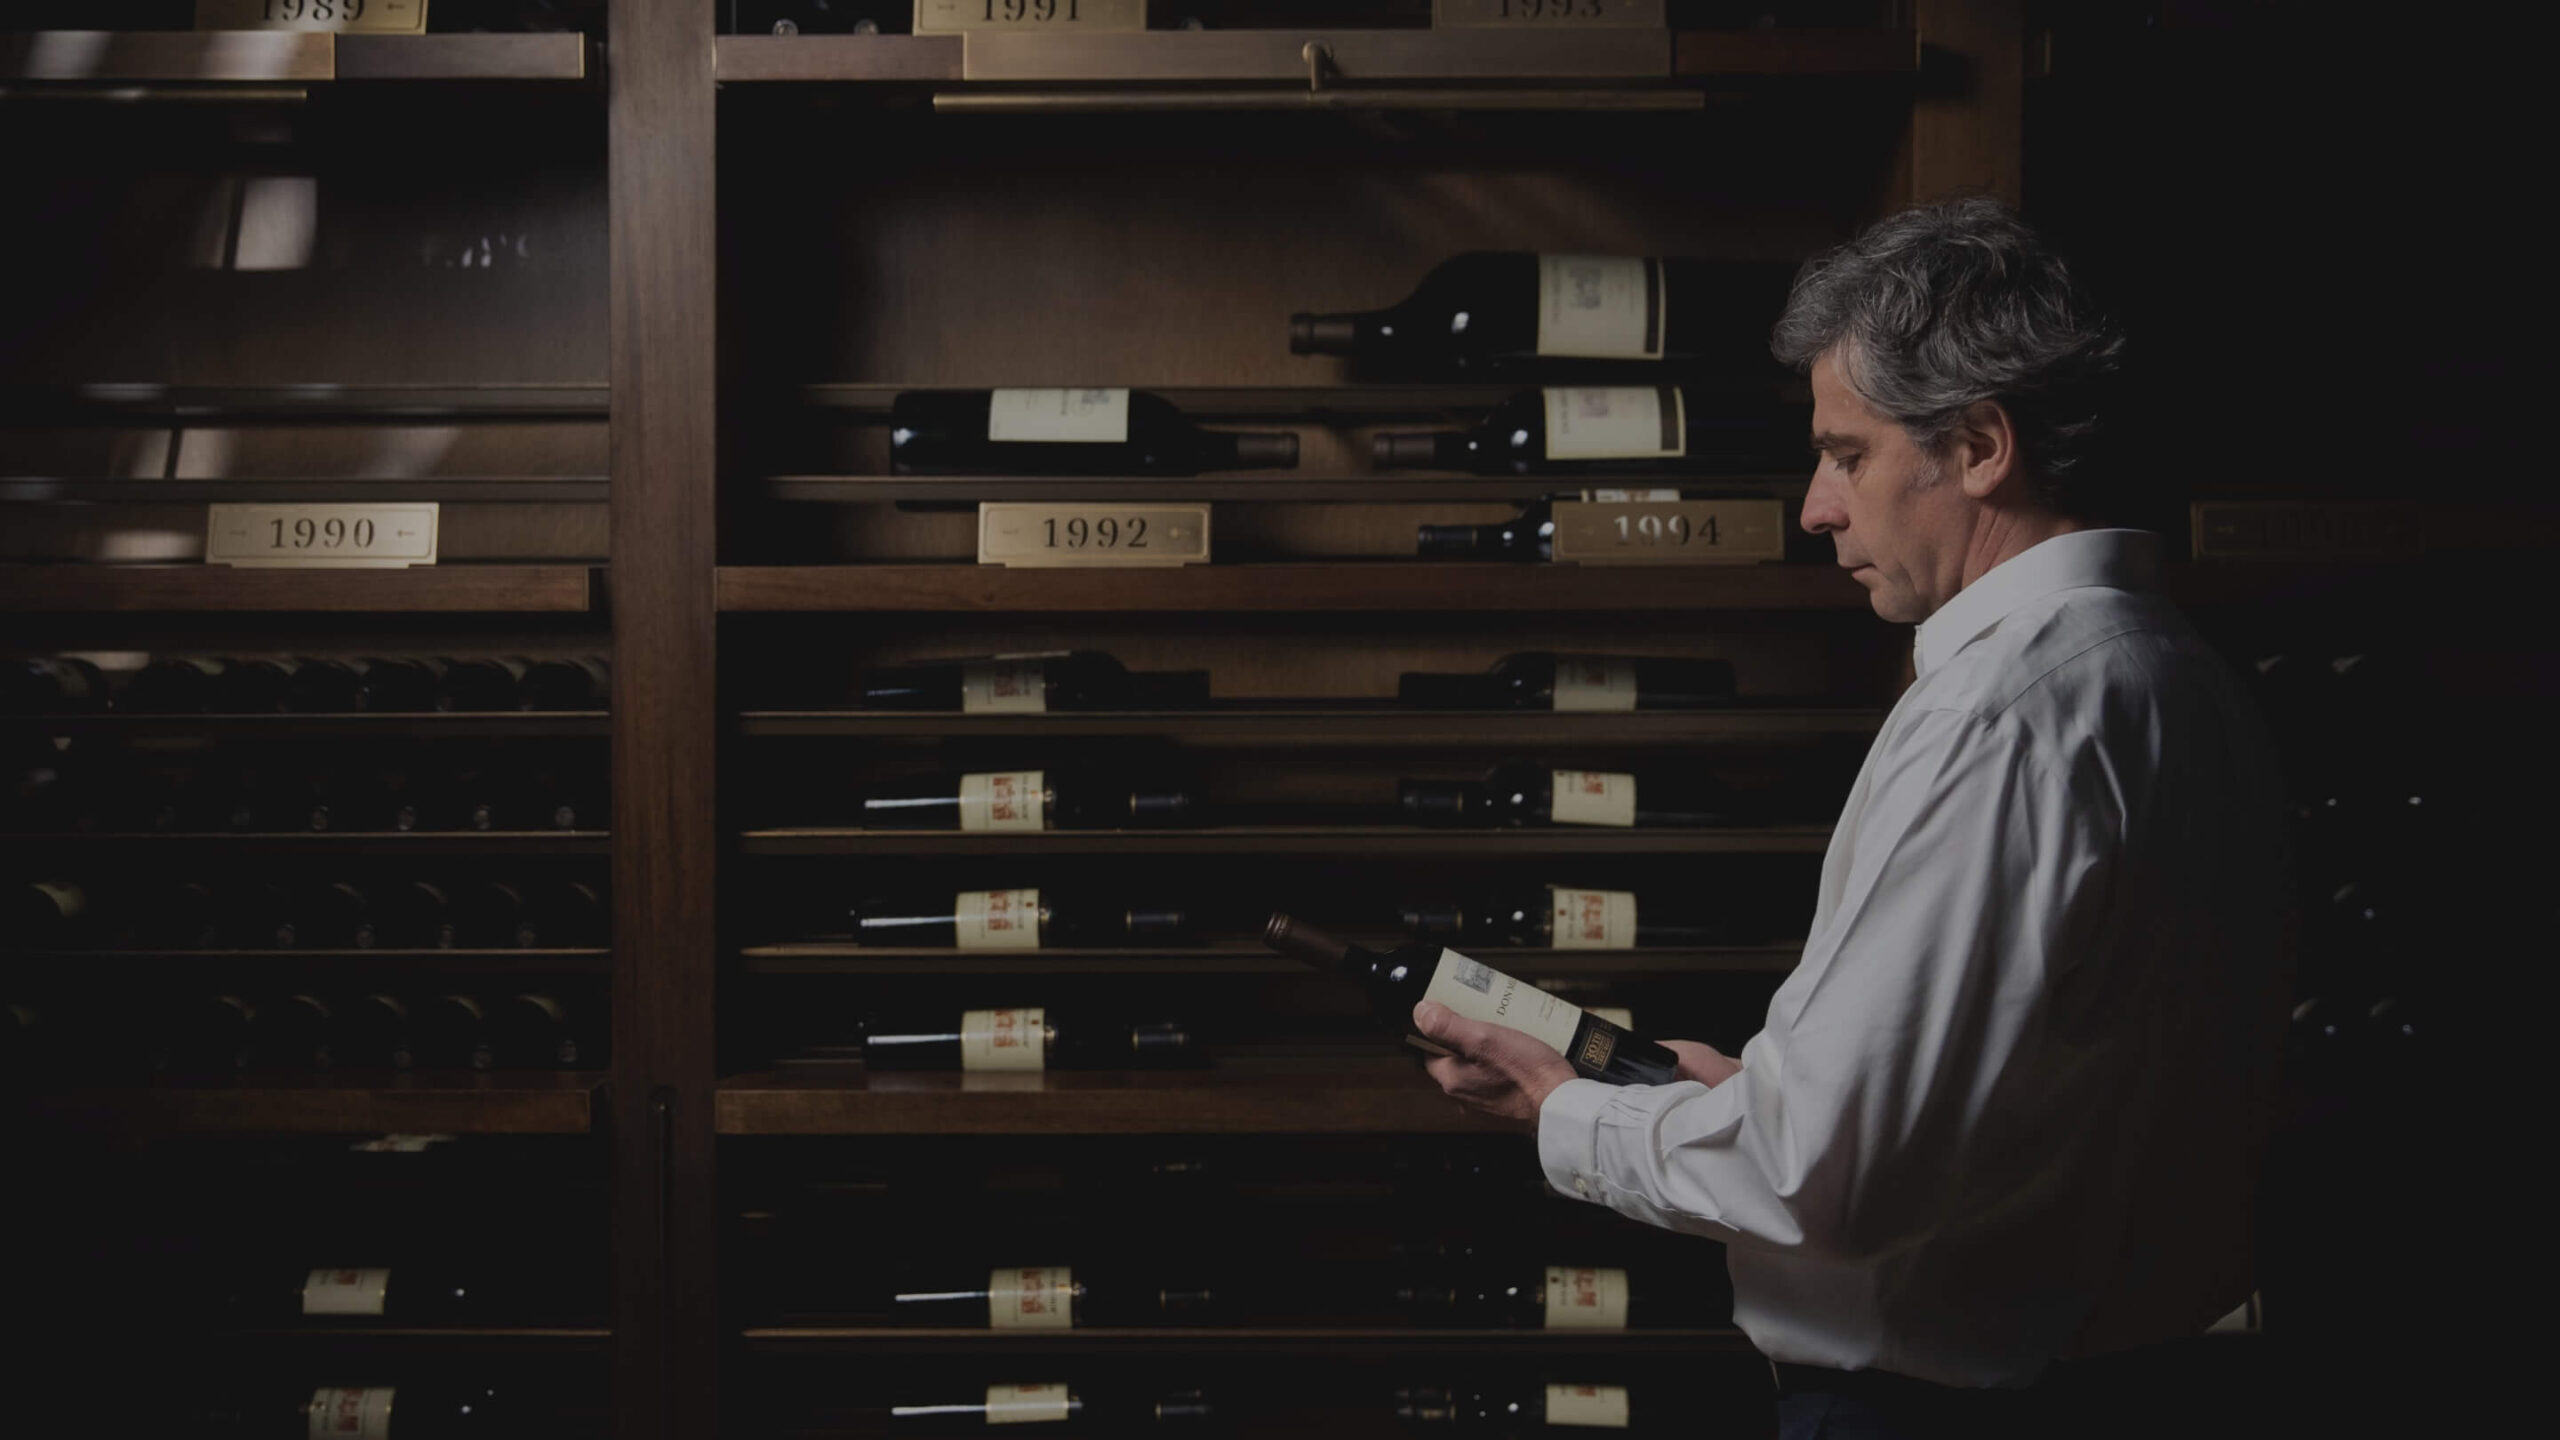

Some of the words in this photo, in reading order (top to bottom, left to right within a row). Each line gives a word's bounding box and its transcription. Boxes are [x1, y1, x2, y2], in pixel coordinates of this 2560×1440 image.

[257, 0, 365, 21] 1989
[981, 0, 1080, 21] 1991
[1497, 0, 1602, 18] 1993
[270, 517, 375, 549] 1990
[1043, 517, 1148, 549] 1992
[1613, 514, 1723, 547] 1994
[1496, 989, 1513, 1016] DON
